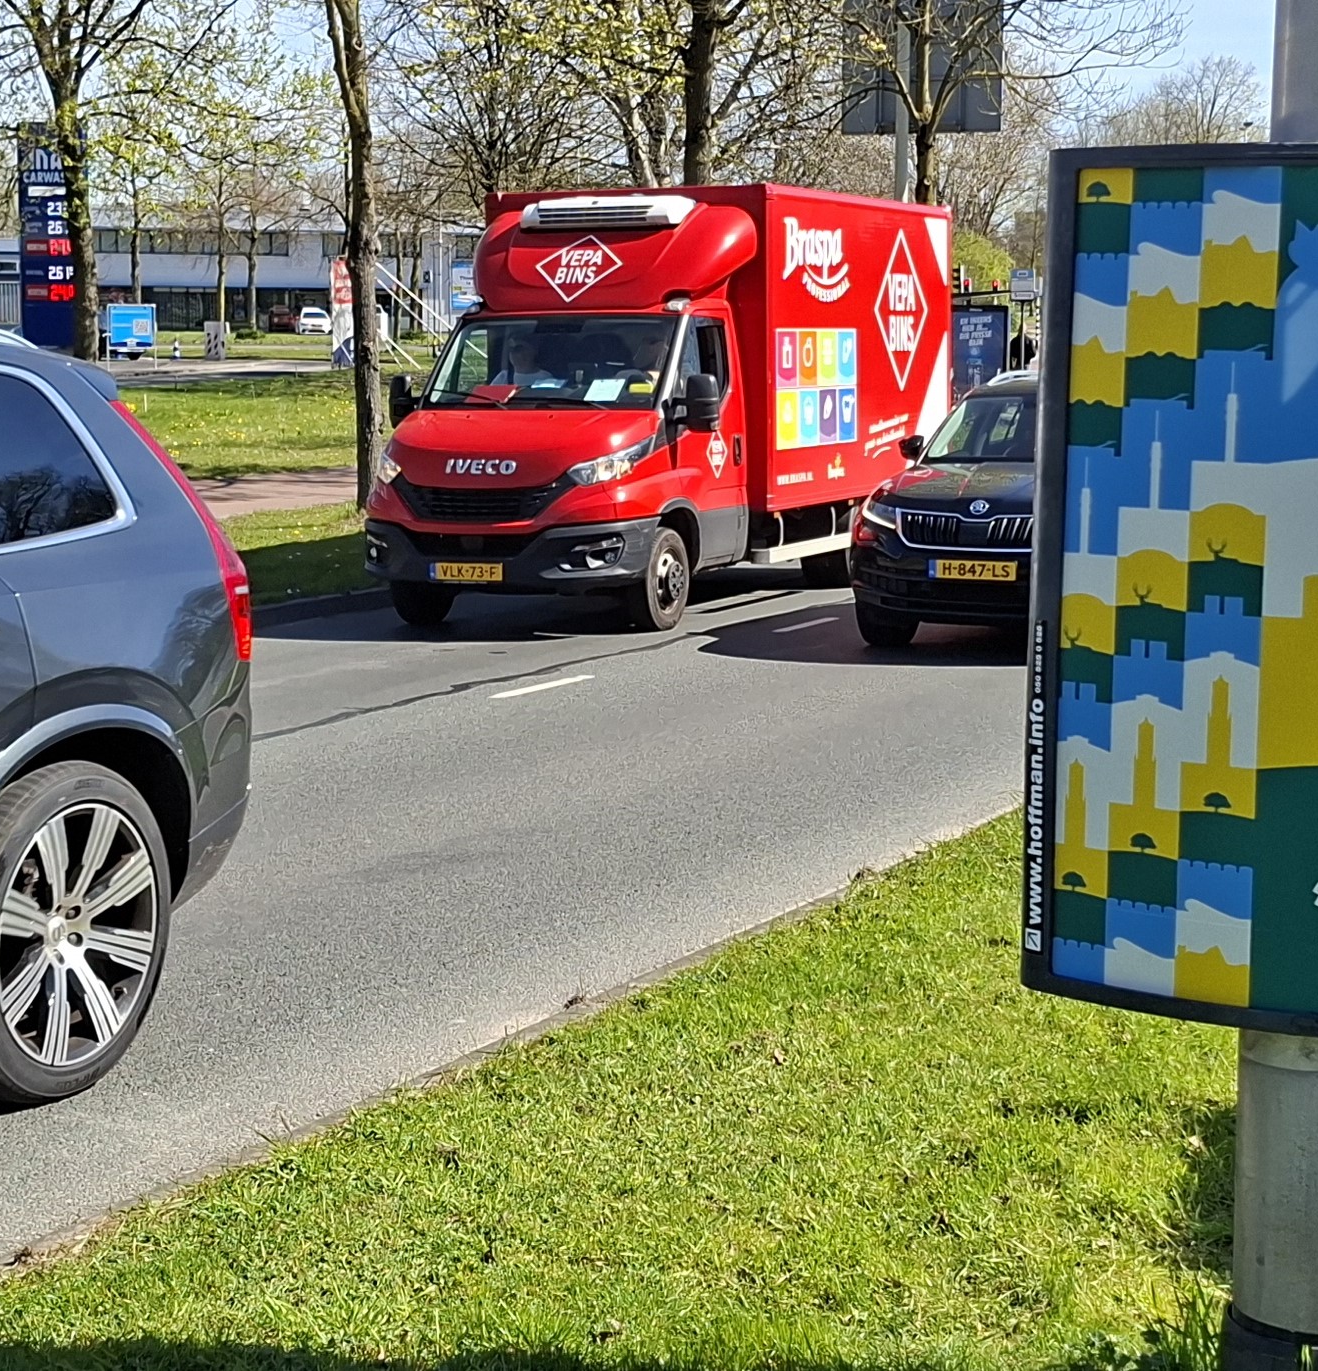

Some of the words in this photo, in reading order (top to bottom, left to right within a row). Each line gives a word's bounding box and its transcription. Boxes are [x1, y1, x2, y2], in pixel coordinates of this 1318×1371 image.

[22, 171, 66, 184] CARWAS
[561, 249, 603, 266] VEPA
[783, 216, 845, 284] Braspa
[554, 266, 597, 284] BINS
[802, 271, 851, 303] PROFESSIONAL
[887, 273, 916, 311] VEPA
[888, 315, 915, 351] BINS
[445, 458, 517, 475] IVECO
[441, 565, 499, 579] VLK-73-F
[942, 562, 1010, 578] H-847-LS
[1027, 698, 1044, 925] www.hoffman.info
